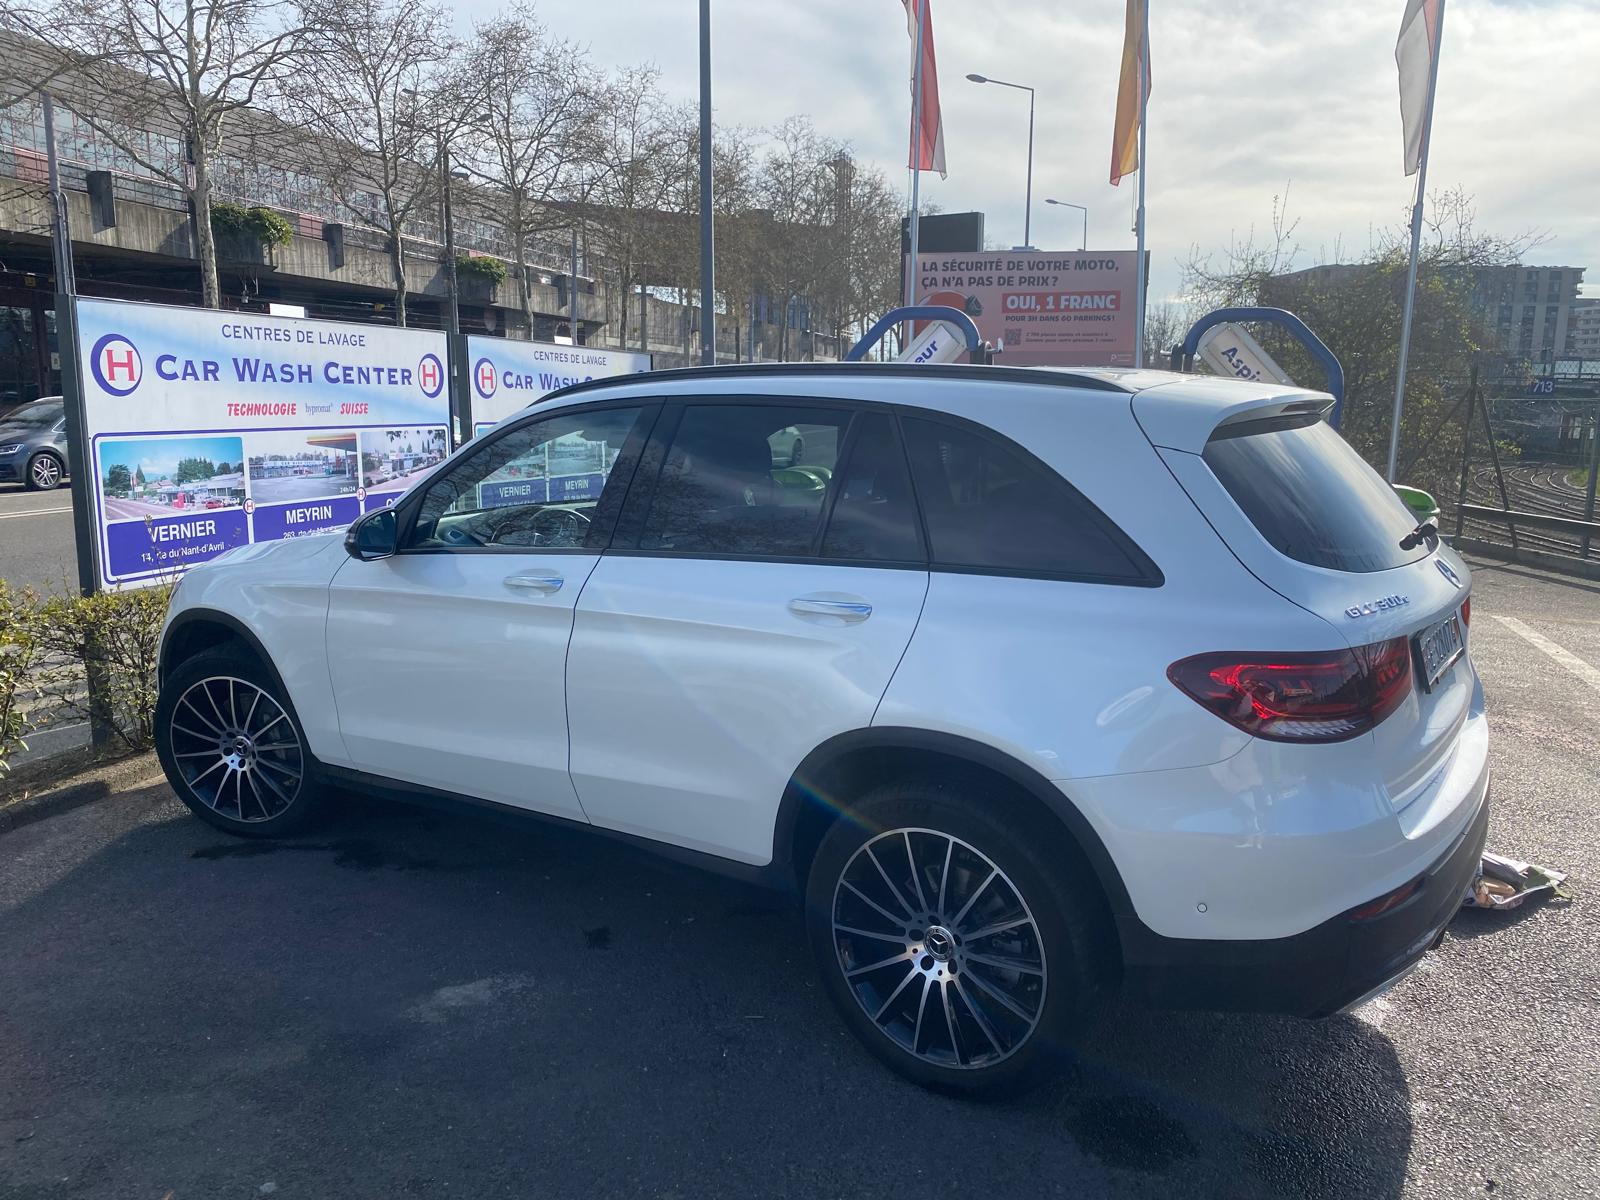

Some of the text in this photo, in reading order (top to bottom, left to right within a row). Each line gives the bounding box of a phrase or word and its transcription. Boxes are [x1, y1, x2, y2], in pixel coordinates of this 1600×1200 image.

[922, 258, 1119, 272] LA SÉCURITÉ DE VOTRE MOTO,
[921, 276, 938, 290] ÇA
[968, 276, 993, 287] PAS
[997, 276, 1014, 287] DE
[1006, 294, 1117, 312] OUI, 1 FRANC
[221, 324, 366, 348] CENTRES DE LAVAGE
[105, 349, 136, 382] H
[533, 351, 607, 366] CENTRES DE LAVAGE
[1221, 347, 1260, 381] Aspi
[227, 403, 297, 417] TECHNOLOGIE
[340, 402, 369, 415] SUISSE
[499, 484, 531, 498] VERNIER
[565, 479, 589, 491] MEYRIN
[285, 505, 333, 524] MEYRIN
[149, 520, 216, 543] VERNIER
[169, 548, 179, 558] du
